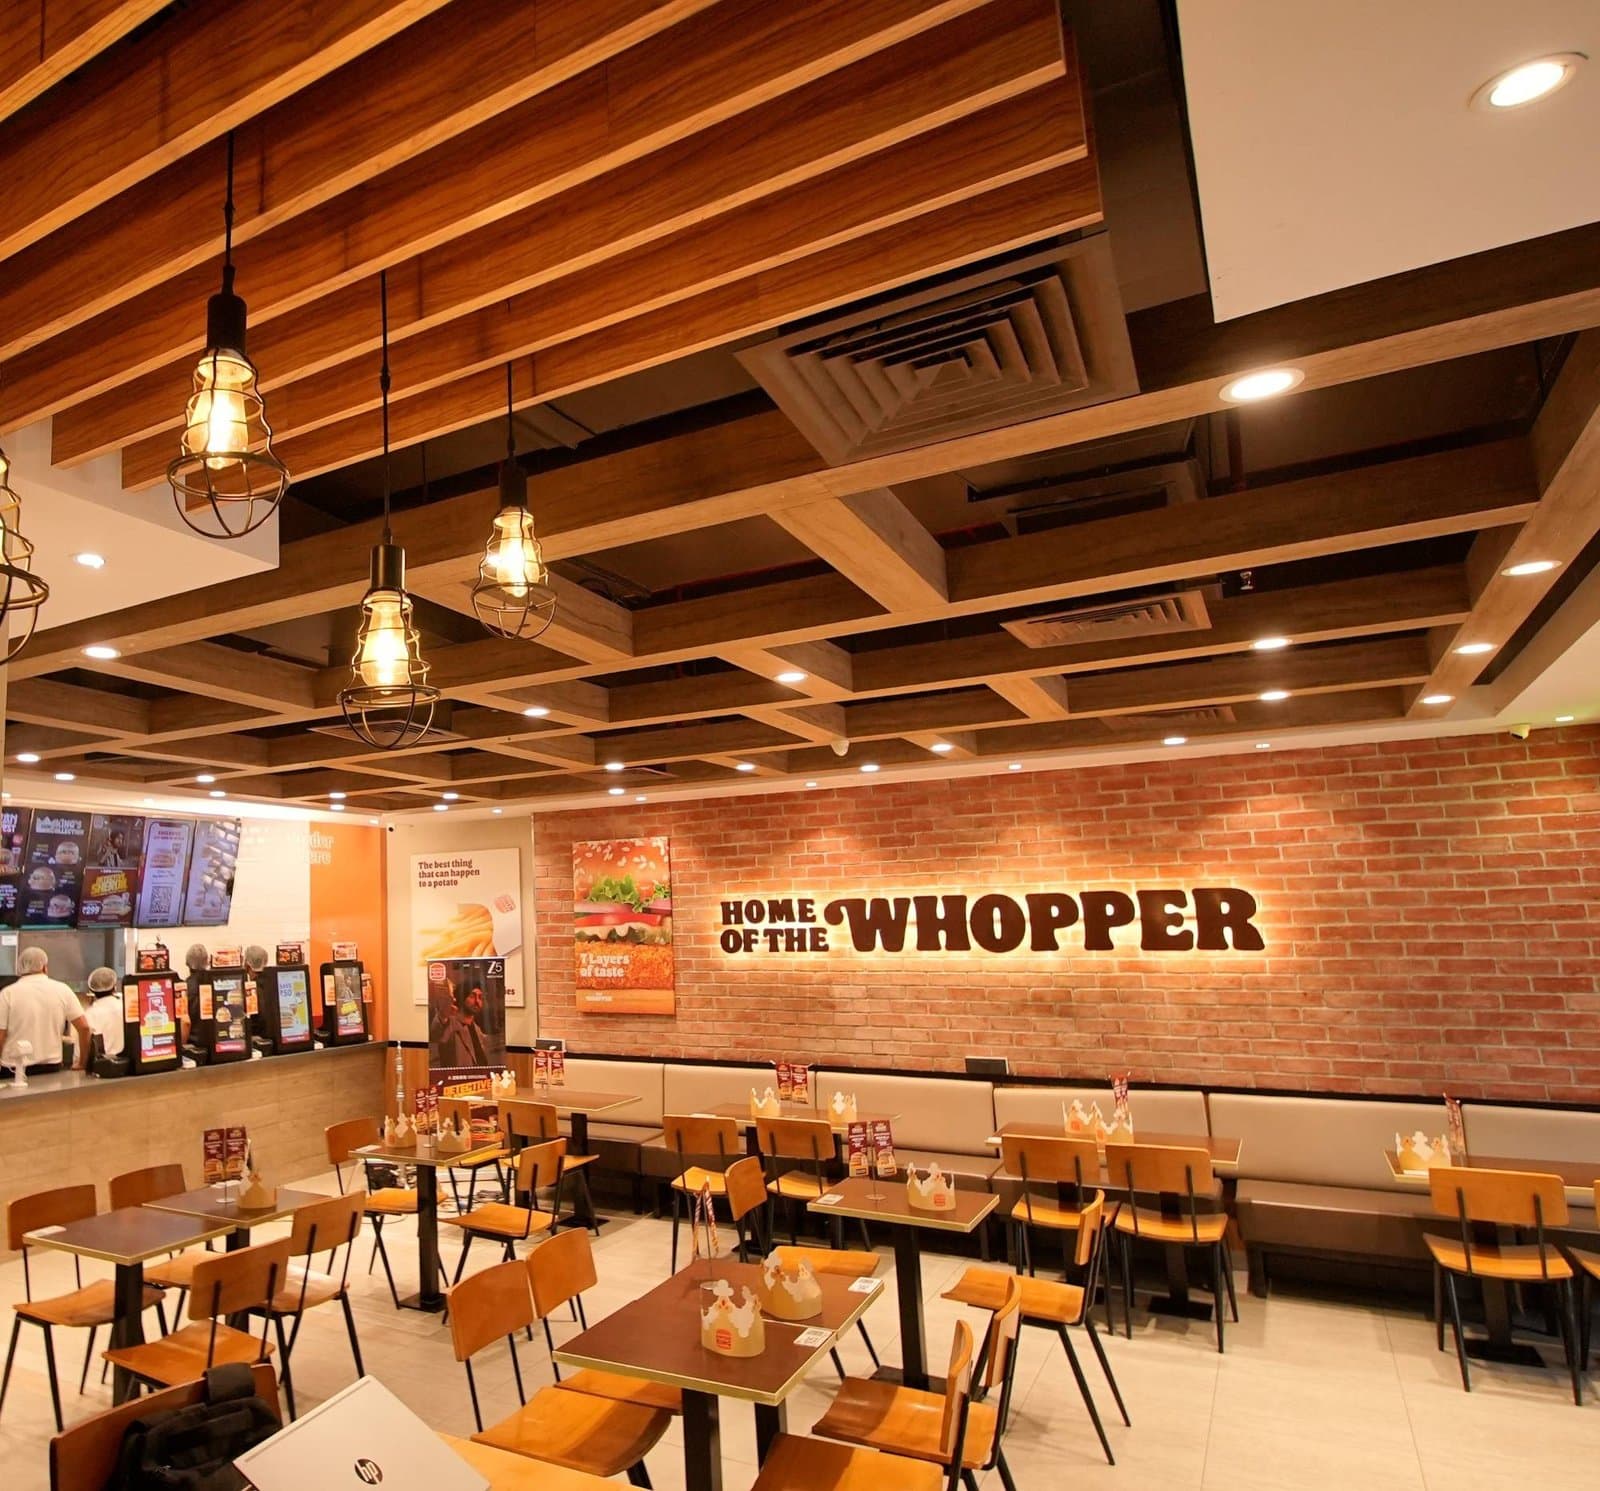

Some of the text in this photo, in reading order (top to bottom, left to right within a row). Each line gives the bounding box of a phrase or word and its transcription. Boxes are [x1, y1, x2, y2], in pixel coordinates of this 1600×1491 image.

[418, 859, 473, 870] The best thing
[450, 869, 480, 878] happen
[433, 879, 458, 888] potato
[720, 887, 1266, 953] HOME WHOPPER
[720, 927, 830, 954] OF THE
[580, 953, 630, 967] 7 Layers
[580, 964, 625, 978] of taste
[443, 1078, 492, 1097] DETECTIVE
[355, 1459, 382, 1484] hp
